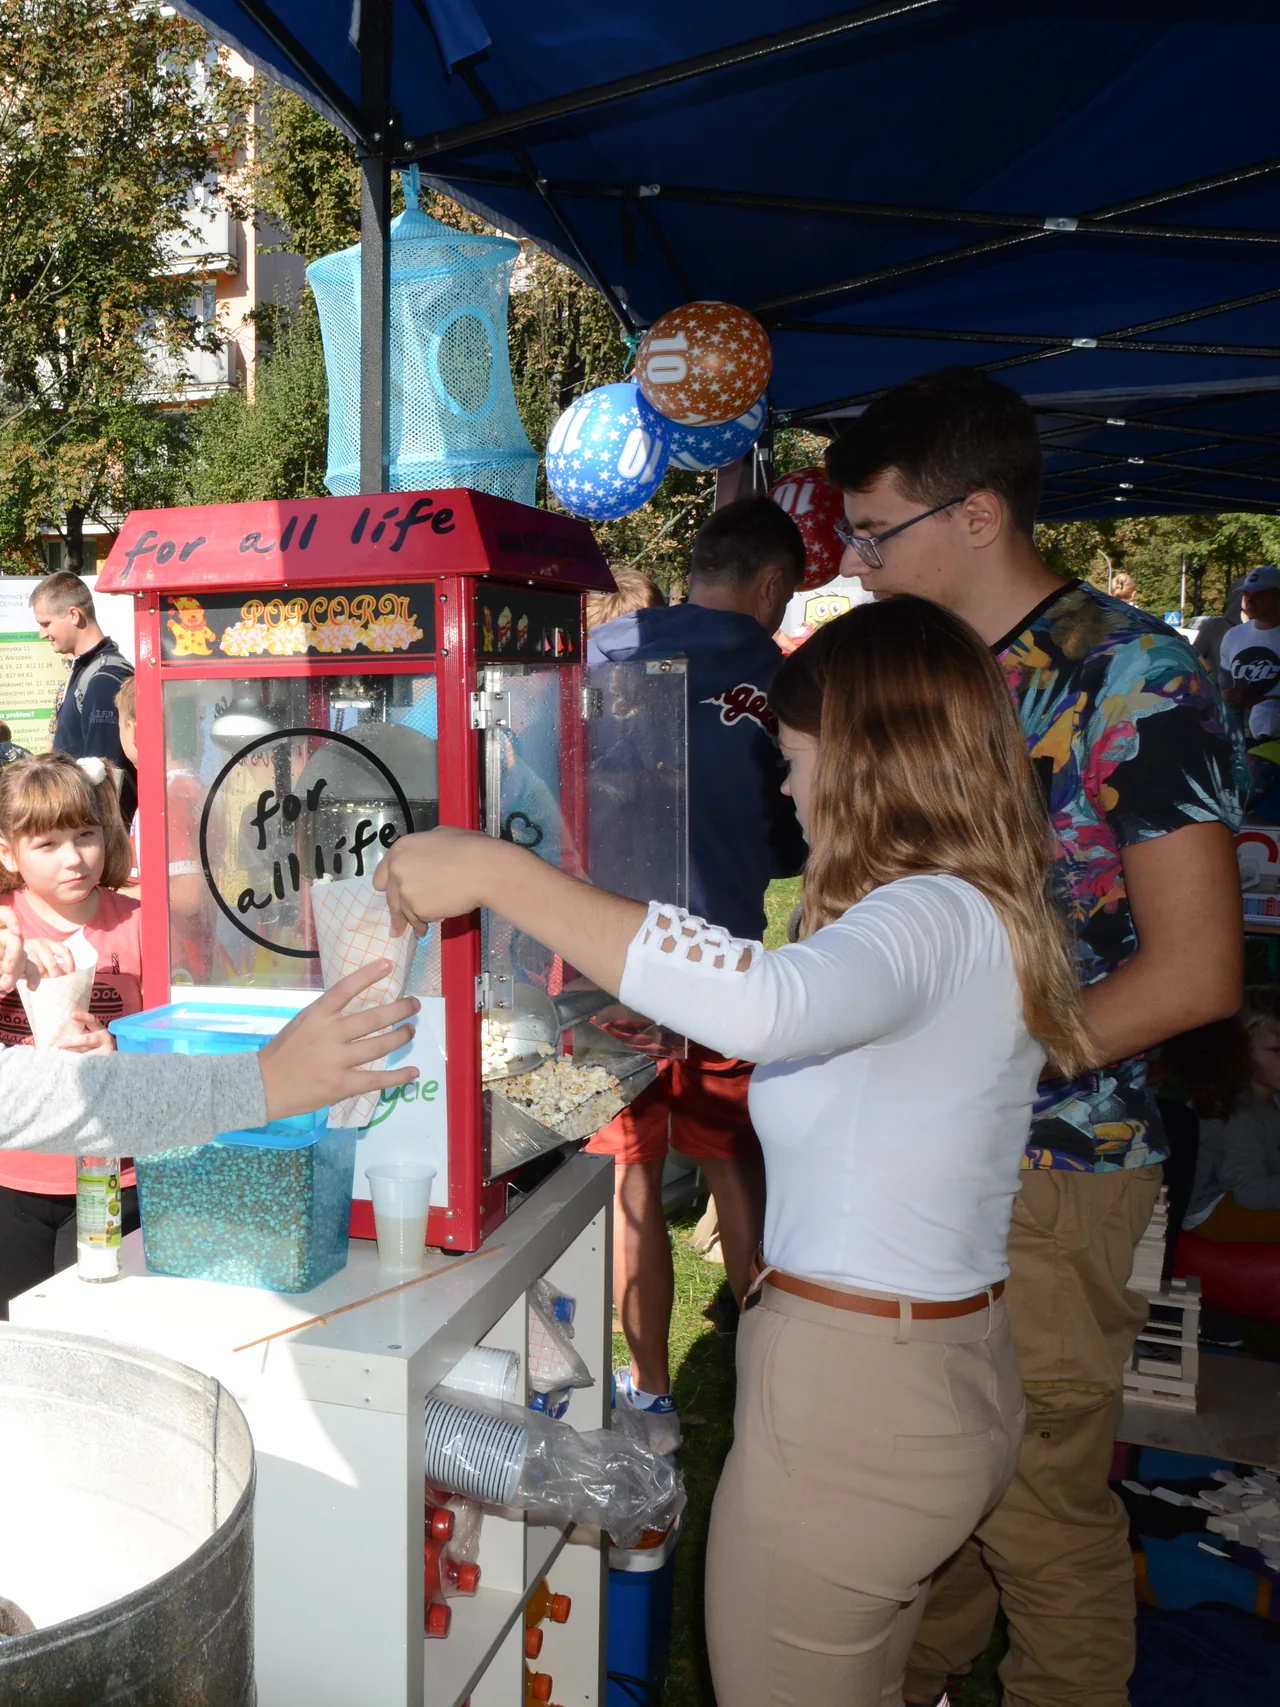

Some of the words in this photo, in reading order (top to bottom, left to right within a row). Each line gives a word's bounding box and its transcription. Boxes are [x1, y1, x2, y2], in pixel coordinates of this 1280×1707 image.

[647, 330, 689, 385] 10
[617, 427, 663, 485] 10
[120, 529, 207, 586] for
[238, 513, 319, 554] all
[350, 497, 456, 552] life
[0, 600, 24, 608] Ochota
[240, 593, 417, 629] POPCORN
[6, 711, 35, 720] problem?
[250, 778, 328, 851] for
[237, 852, 301, 914] all
[315, 819, 402, 879] life
